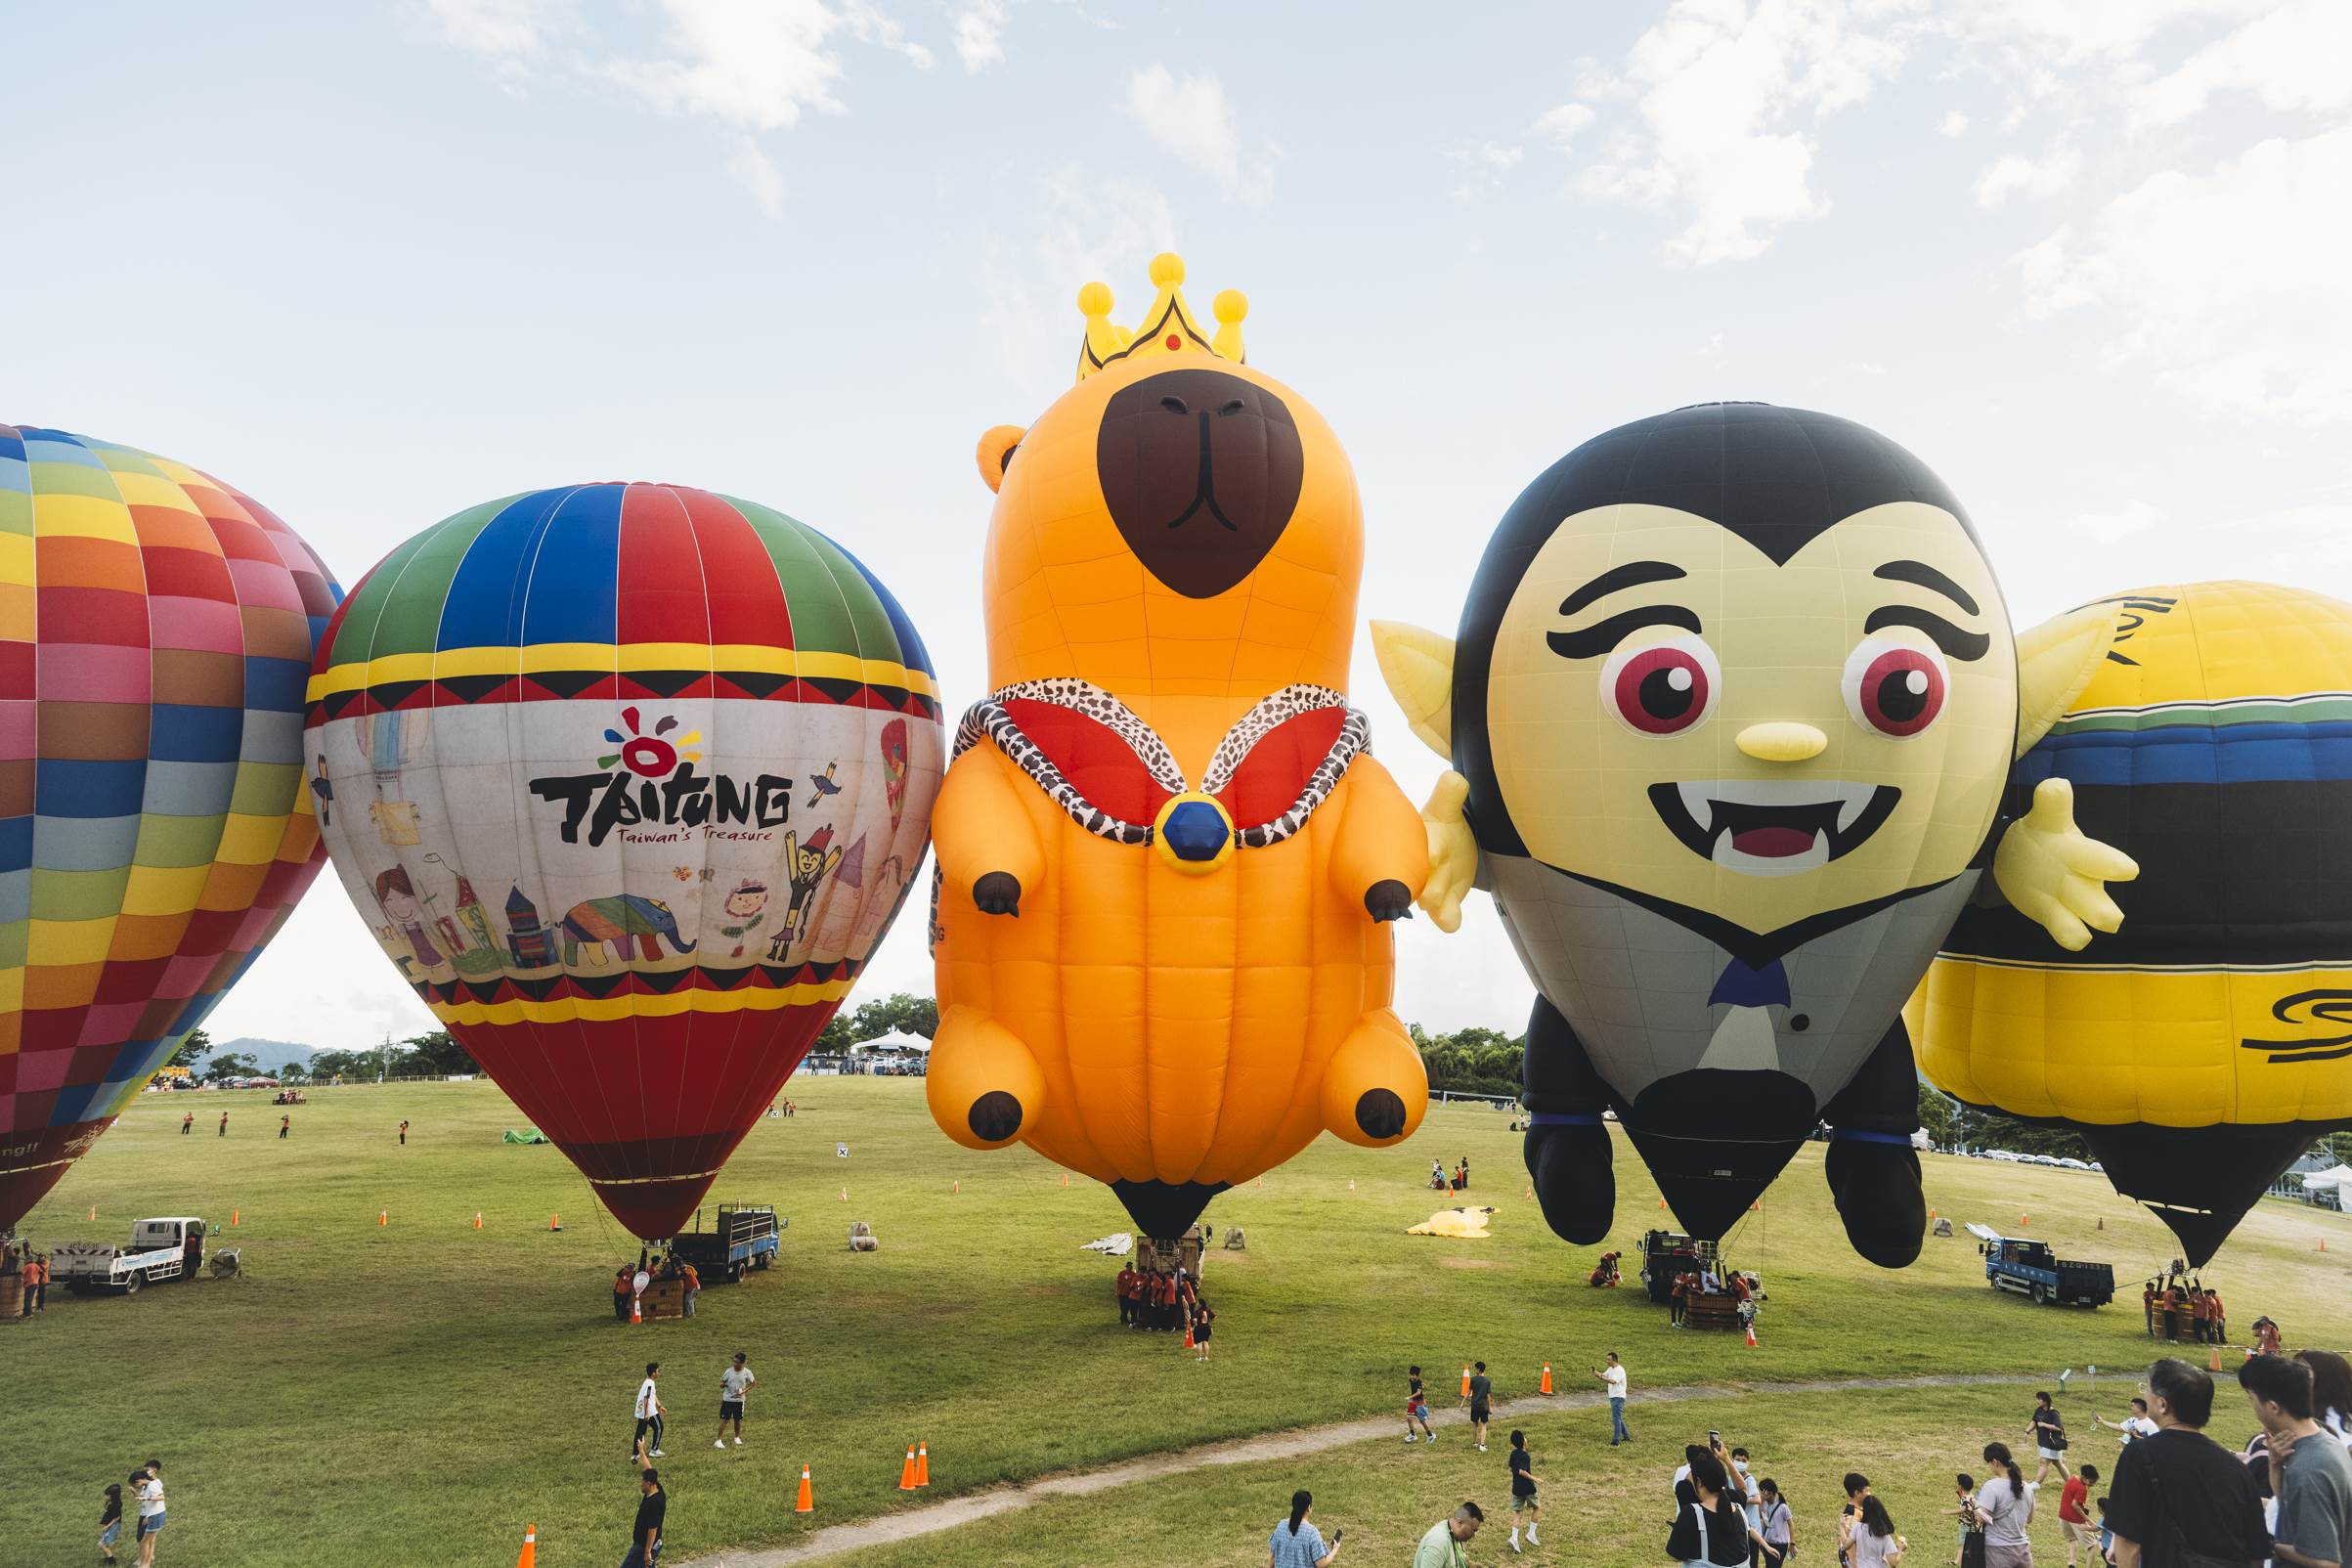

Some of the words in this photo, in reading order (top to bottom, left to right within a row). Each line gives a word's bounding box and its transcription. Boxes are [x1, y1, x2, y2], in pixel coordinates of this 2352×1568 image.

[616, 826, 691, 845] Taiwan's
[701, 824, 773, 842] Treasure
[0, 1142, 39, 1157] ng!!
